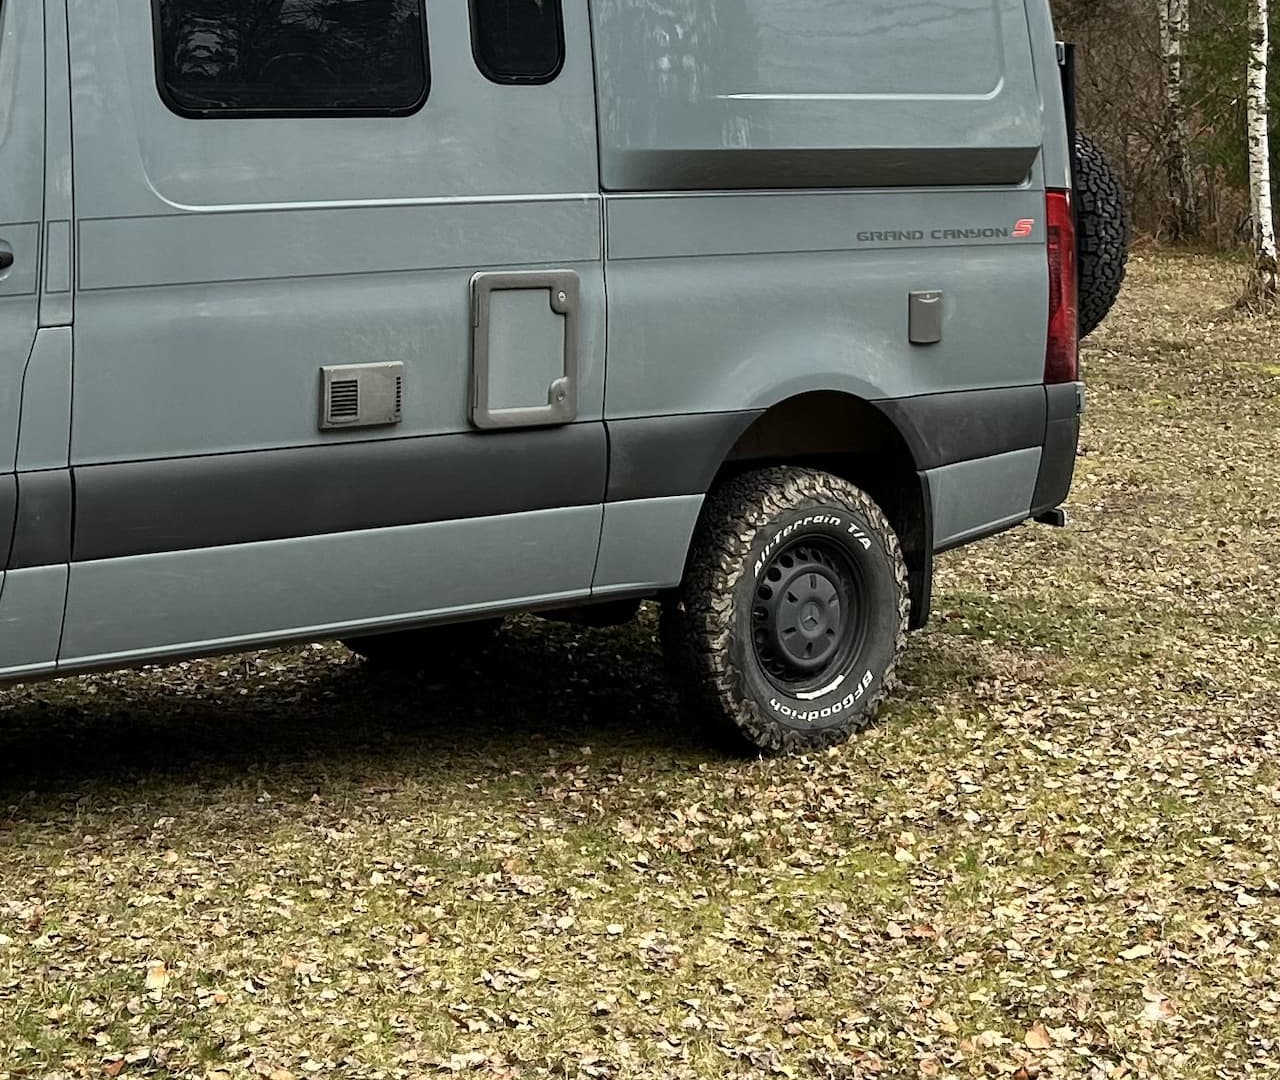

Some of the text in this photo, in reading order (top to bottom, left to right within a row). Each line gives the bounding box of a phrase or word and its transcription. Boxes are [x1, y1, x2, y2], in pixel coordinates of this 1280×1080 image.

[855, 218, 1035, 242] GRAND CANYON S
[753, 514, 872, 578] All-Terrain T/A
[769, 669, 874, 722] BFGoodrich
